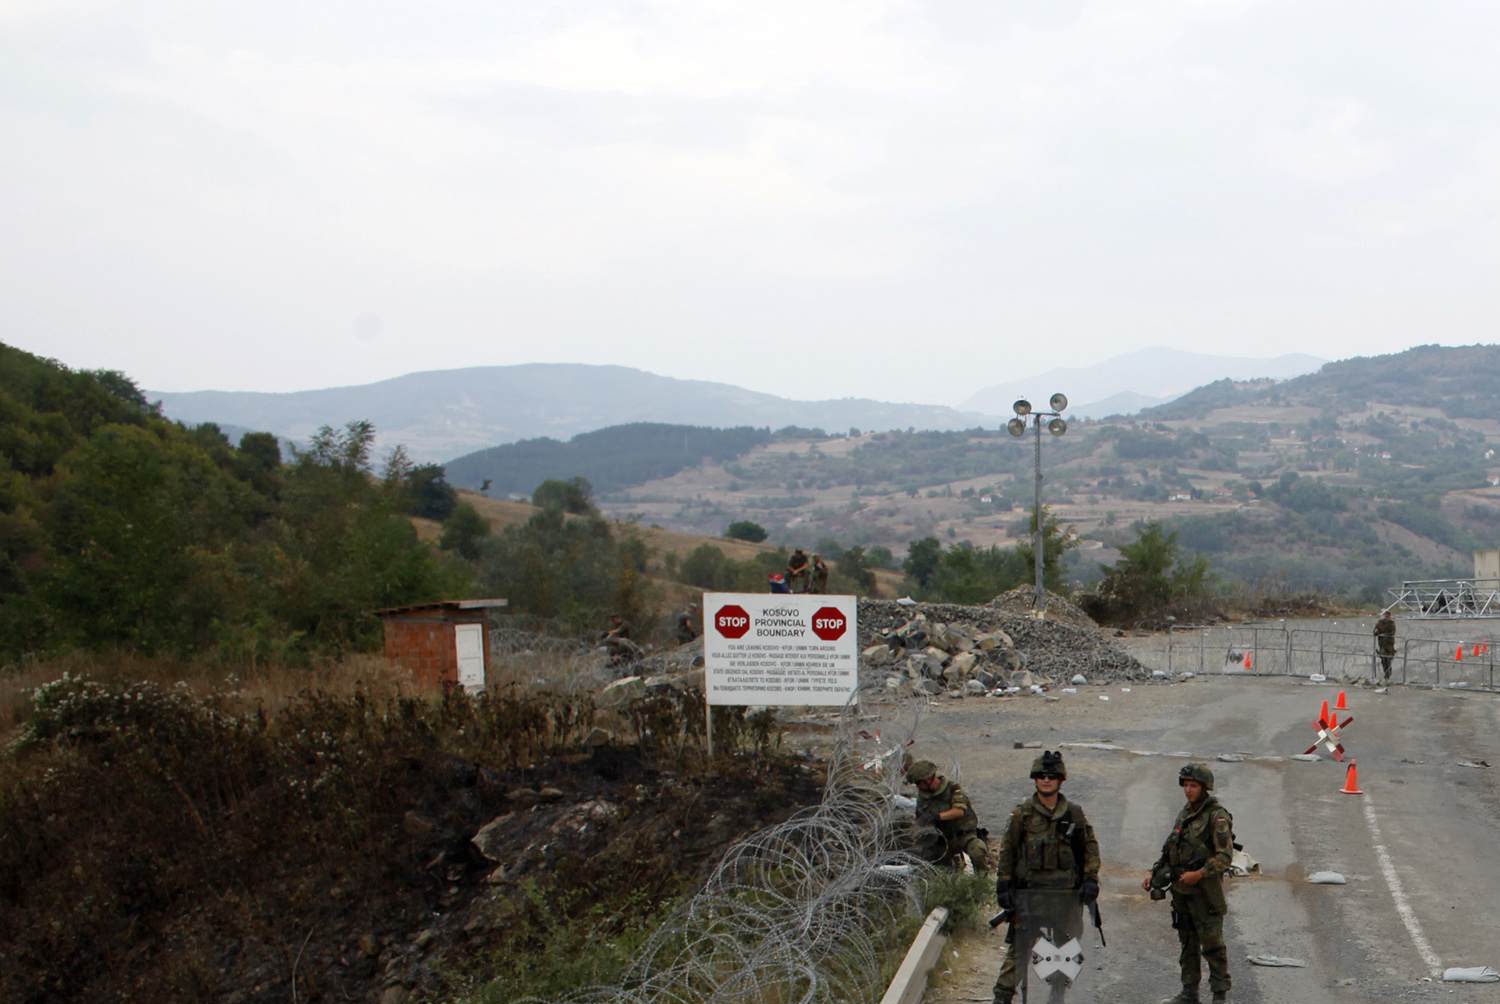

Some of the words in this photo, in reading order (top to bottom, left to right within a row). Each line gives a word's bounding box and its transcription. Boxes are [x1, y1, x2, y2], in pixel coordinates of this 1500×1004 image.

[762, 608, 800, 617] KOSOVO
[719, 616, 747, 627] STOP
[754, 618, 807, 627] PROVINCIAL
[815, 618, 844, 629] STOP
[756, 628, 806, 637] BOUNDARY
